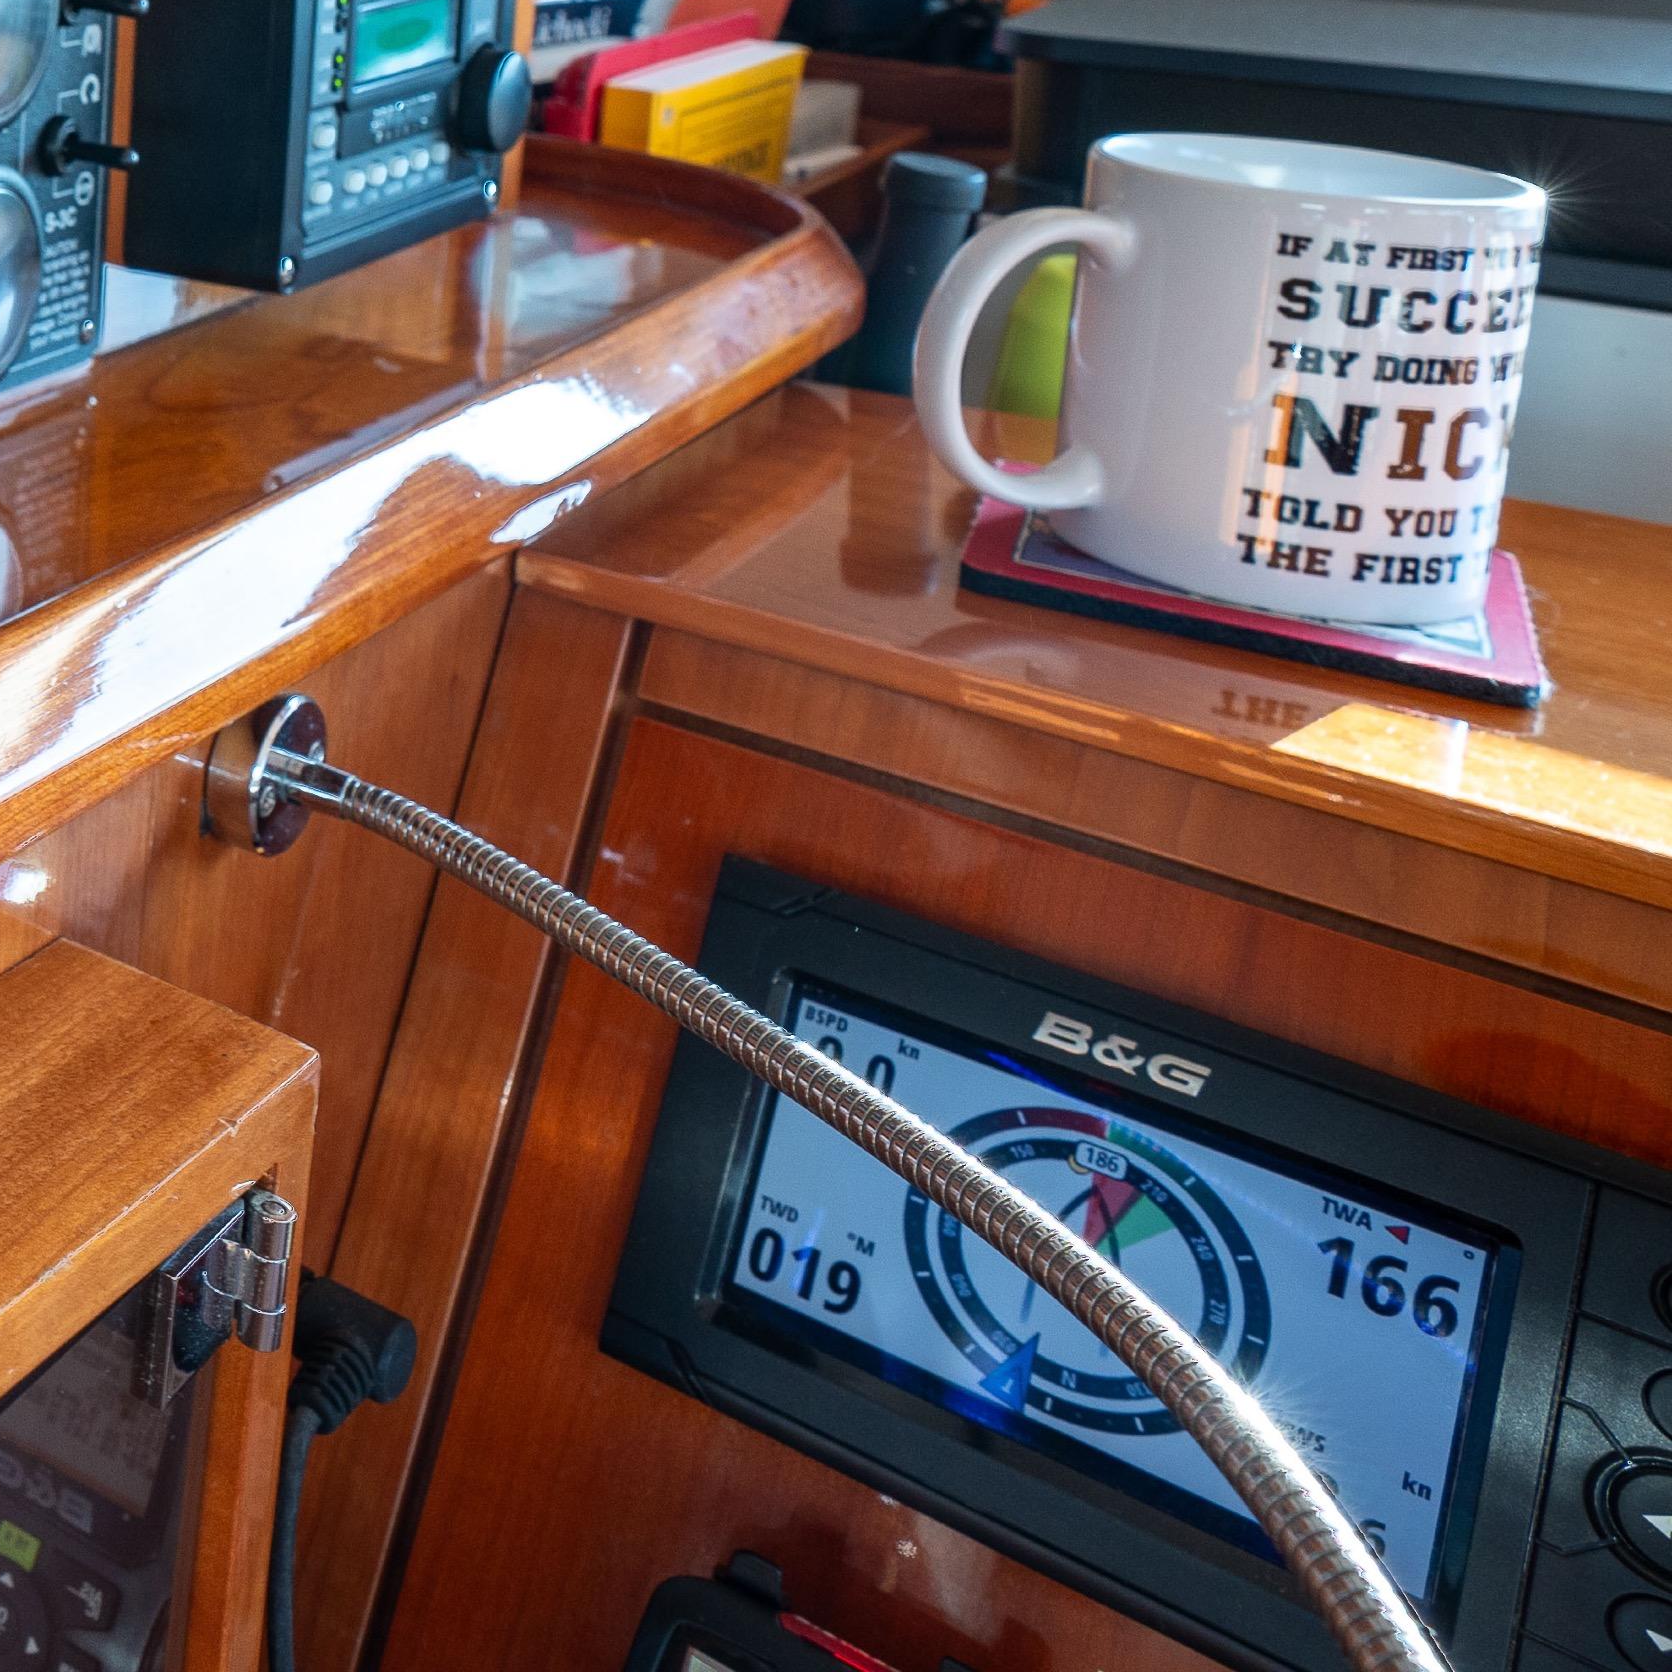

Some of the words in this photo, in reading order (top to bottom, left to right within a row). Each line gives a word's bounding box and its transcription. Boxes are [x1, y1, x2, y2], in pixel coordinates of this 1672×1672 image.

[1277, 234, 1313, 258] IF
[1324, 240, 1377, 267] AT
[1386, 246, 1475, 272] FIRST
[1267, 340, 1360, 379] TRY
[1373, 354, 1480, 386] DOING
[1242, 487, 1363, 533] TOLD
[1385, 507, 1460, 538] YOU
[1236, 532, 1334, 578] THE
[1352, 551, 1463, 585] FIRST
[804, 1004, 850, 1033] BSPD
[897, 1038, 921, 1062] kn
[1032, 1011, 1212, 1097] B&G
[1085, 1146, 1120, 1175] 186
[759, 1195, 800, 1225] TWD
[1321, 1195, 1373, 1230] TWA
[748, 1227, 862, 1315] 019
[1317, 1235, 1461, 1339] 166
[1061, 1371, 1077, 1390] N
[1402, 1470, 1433, 1501] kn
